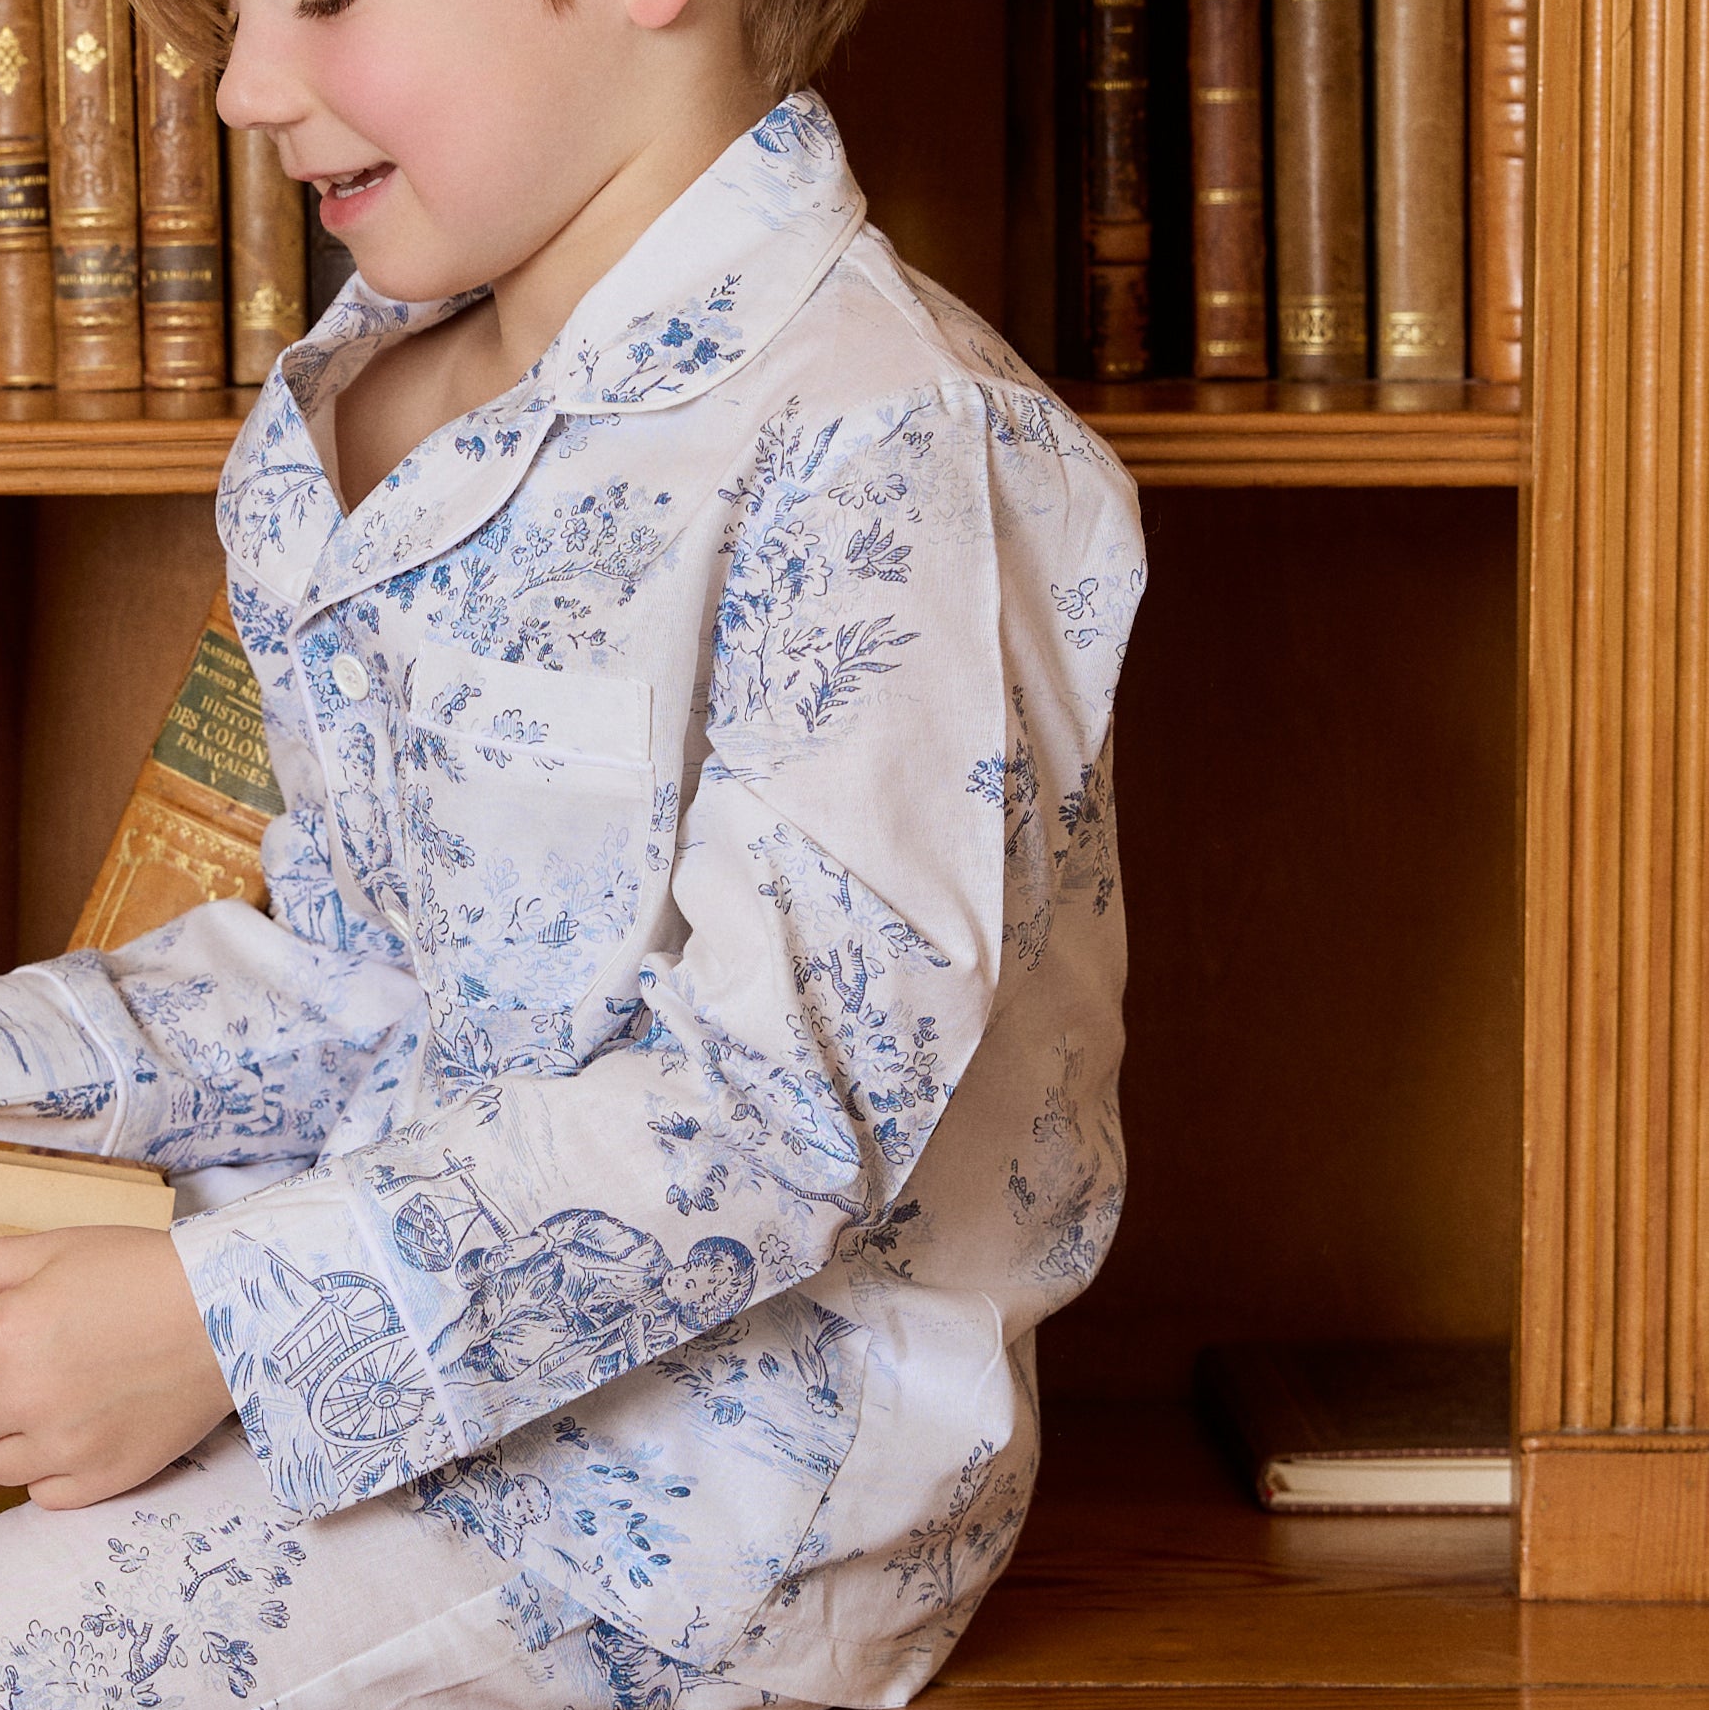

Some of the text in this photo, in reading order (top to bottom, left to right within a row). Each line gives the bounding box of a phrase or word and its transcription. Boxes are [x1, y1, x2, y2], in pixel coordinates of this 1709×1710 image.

[194, 663, 237, 691] ALFRED
[202, 642, 249, 674] GABRIEL
[169, 702, 271, 769] DES COLON
[200, 695, 266, 740] HISTOIR
[177, 732, 271, 788] FRANÇAISES
[210, 770, 223, 785] V
